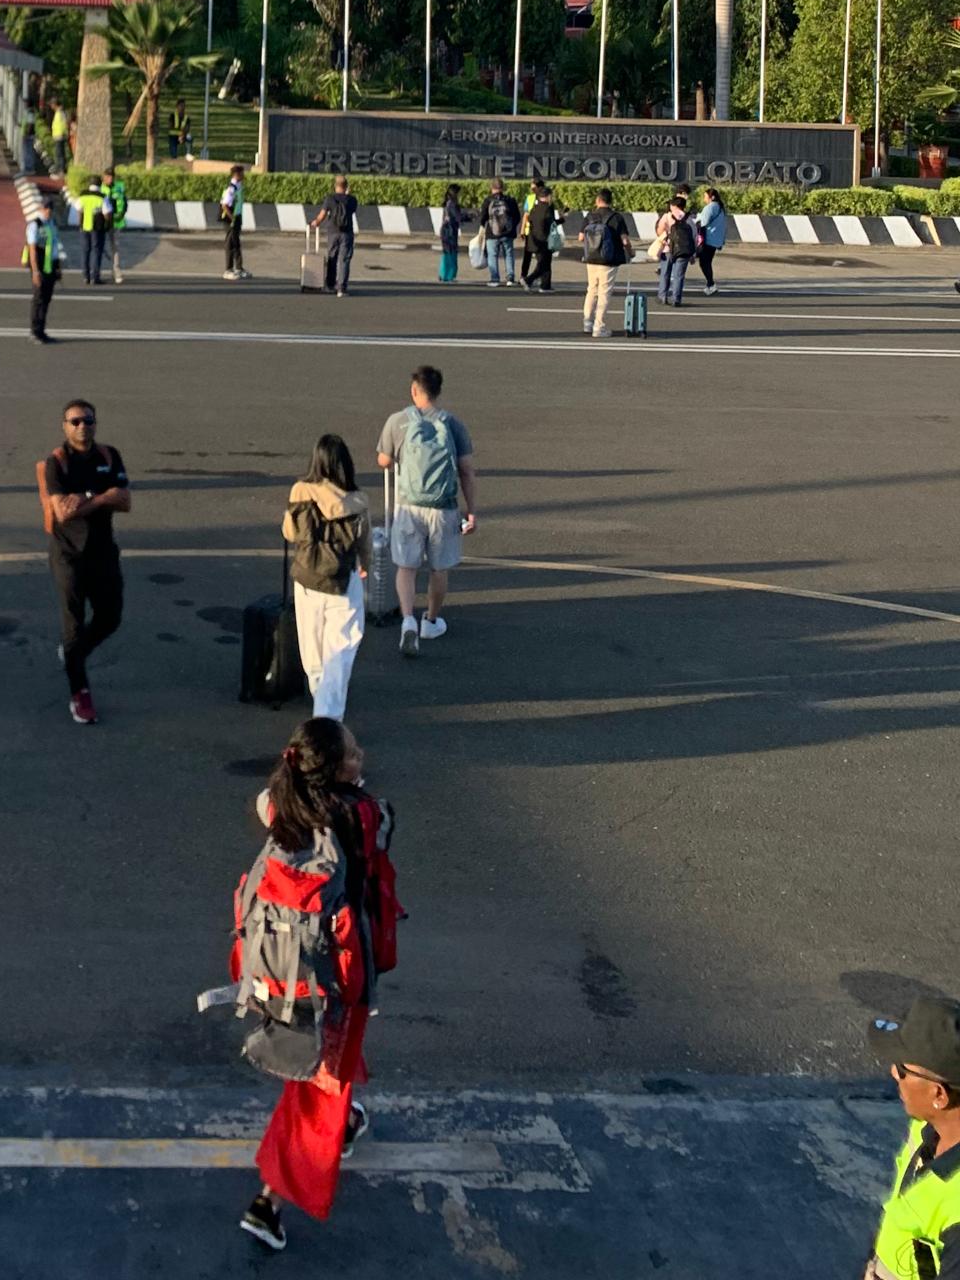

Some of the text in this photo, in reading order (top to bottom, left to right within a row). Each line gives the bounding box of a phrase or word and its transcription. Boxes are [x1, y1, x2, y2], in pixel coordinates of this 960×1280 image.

[439, 128, 686, 148] AEROPORTO INTERNACIONAL
[303, 150, 822, 186] PRESIDENTE NICOLAU LOBATO
